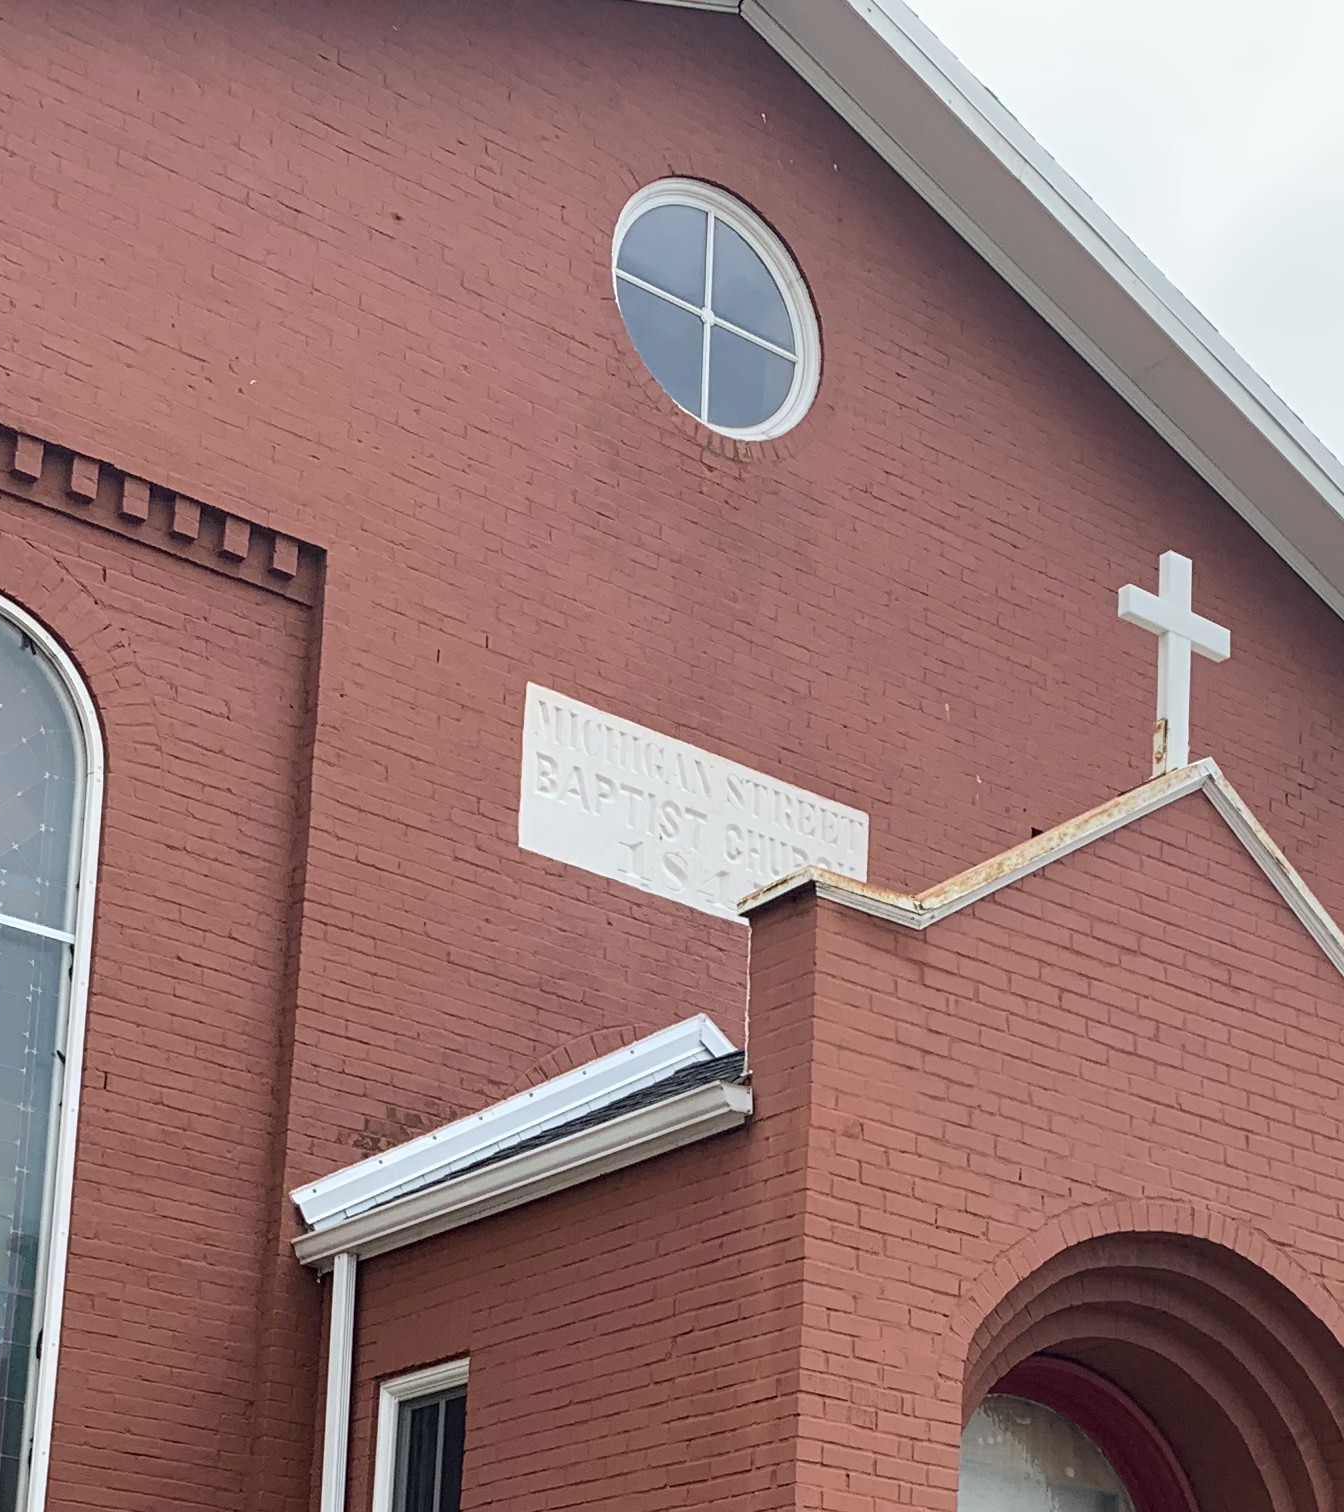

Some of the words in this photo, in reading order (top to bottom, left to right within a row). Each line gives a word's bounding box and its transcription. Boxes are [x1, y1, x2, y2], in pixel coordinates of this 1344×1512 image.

[534, 699, 714, 799] MICHIGAN
[726, 774, 865, 853] STREET
[534, 750, 709, 852] BAPTIST
[725, 823, 856, 877] CHUR
[617, 840, 763, 912] 184
